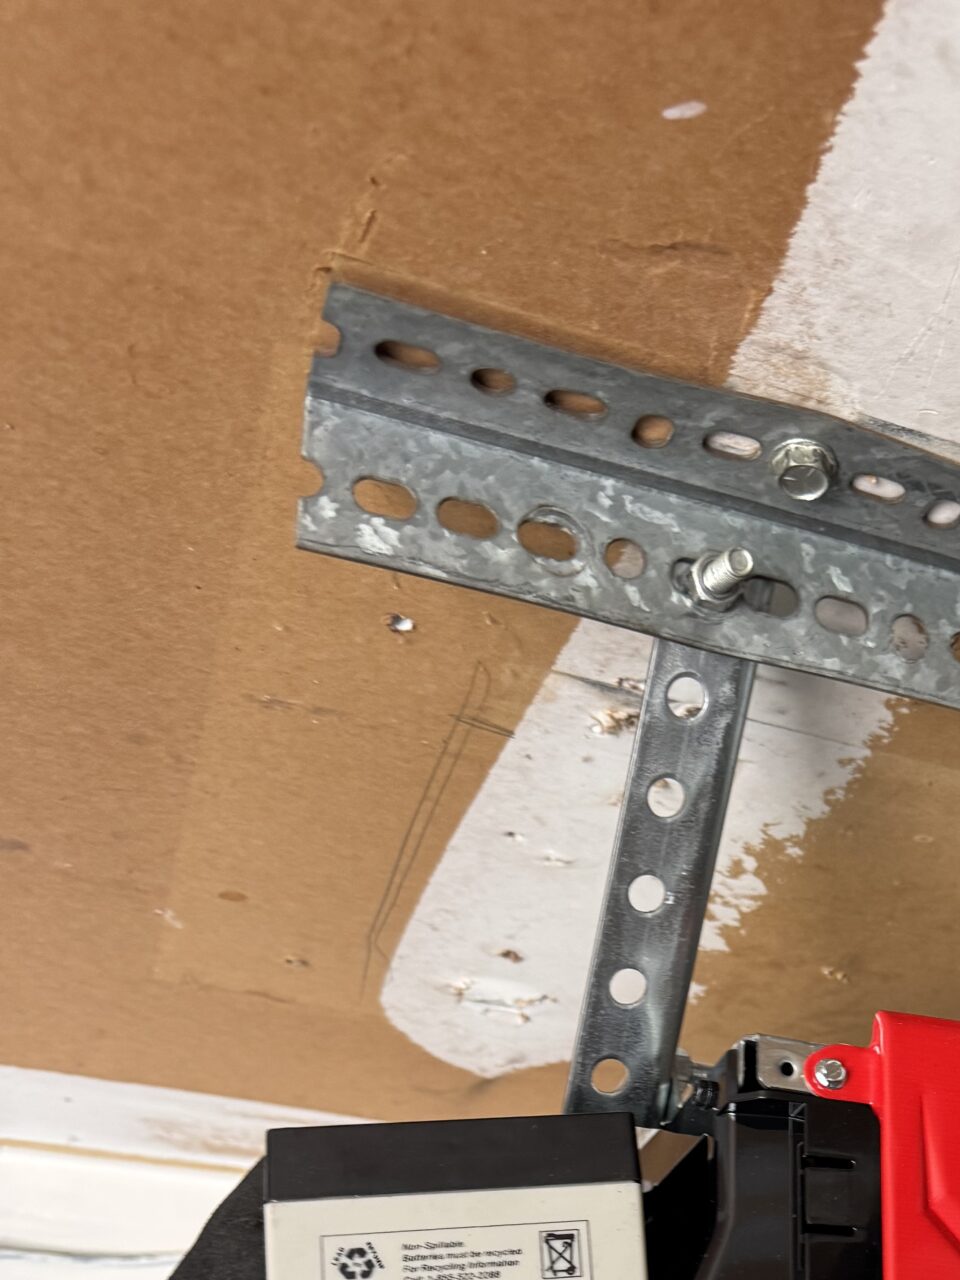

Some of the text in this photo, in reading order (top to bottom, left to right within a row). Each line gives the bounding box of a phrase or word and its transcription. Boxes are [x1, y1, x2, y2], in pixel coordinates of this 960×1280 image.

[402, 1248, 523, 1262] Batteries must be recycled
[421, 1262, 466, 1272] Recycling
